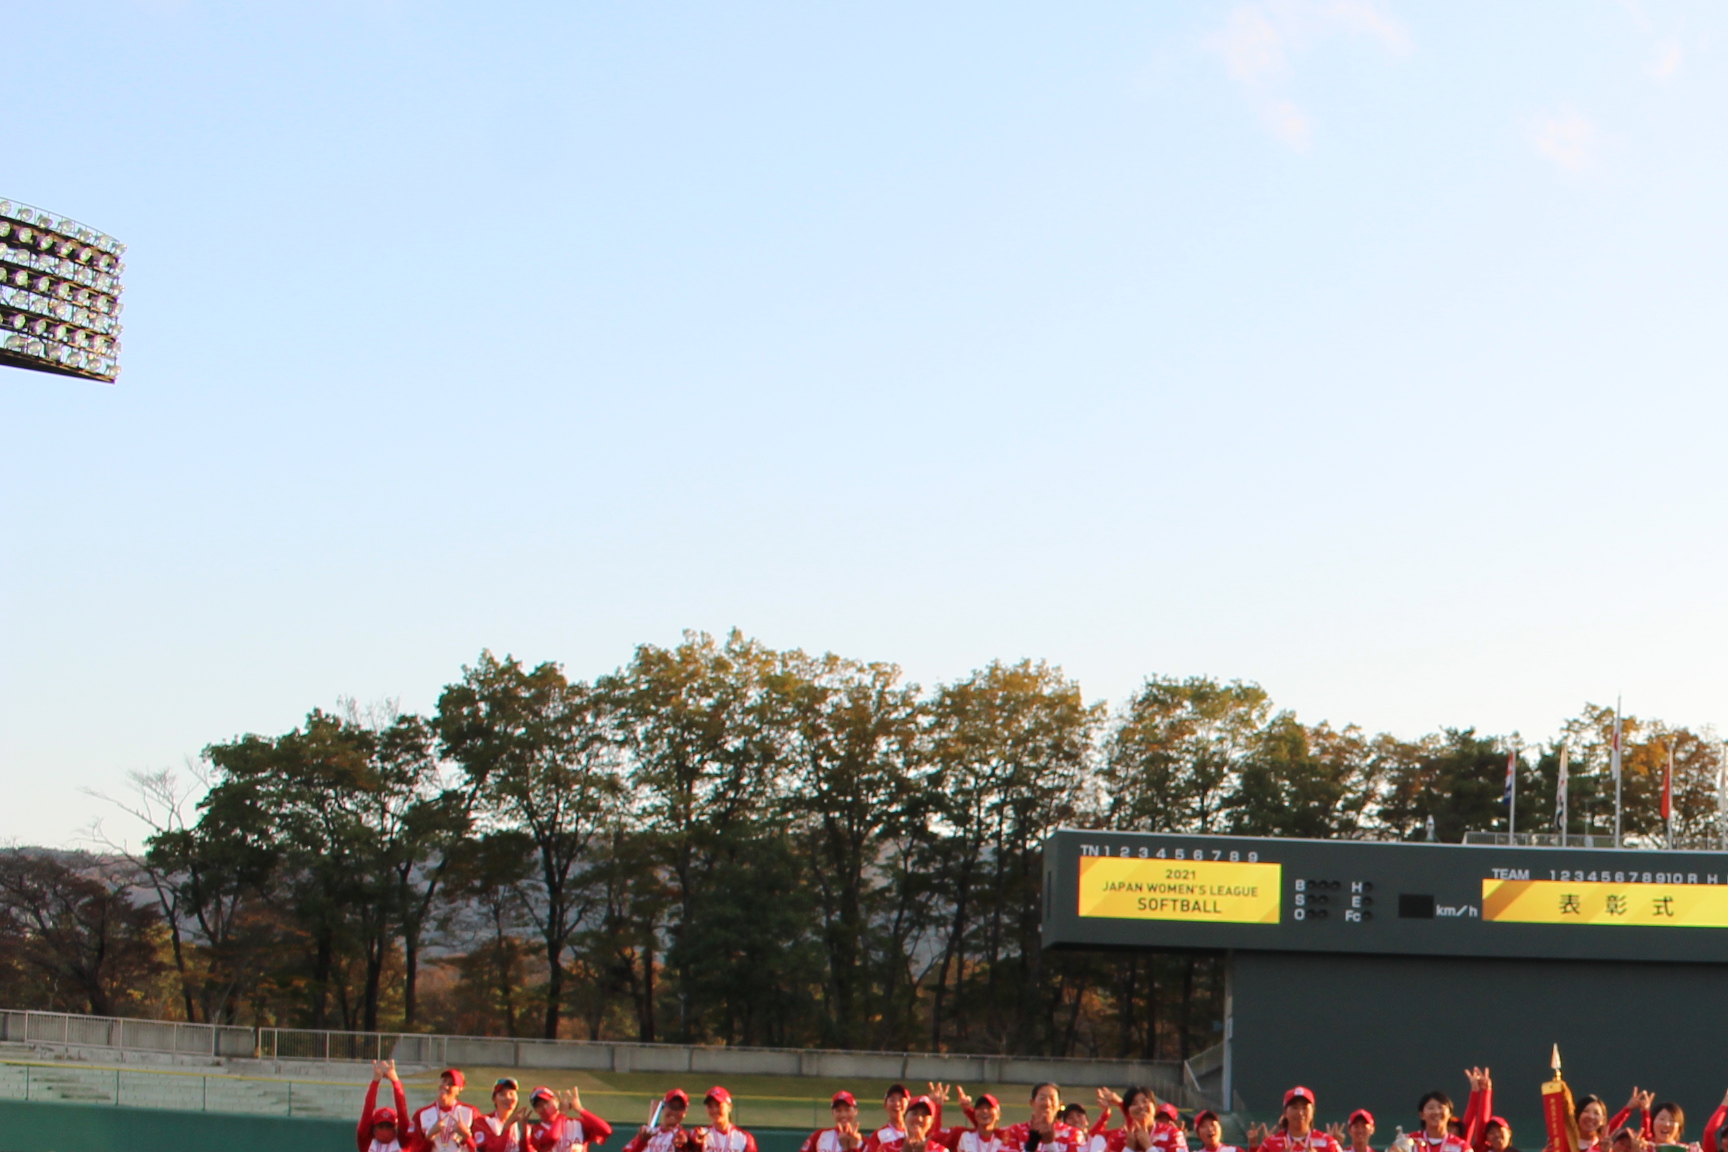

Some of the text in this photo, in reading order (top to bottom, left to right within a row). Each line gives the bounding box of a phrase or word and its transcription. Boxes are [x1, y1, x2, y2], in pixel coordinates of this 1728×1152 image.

[1080, 844, 1258, 863] TN 1 2 3 4 5 6 7 8 9
[1165, 869, 1197, 880] 2021
[1491, 868, 1530, 880] TEAM
[1549, 870, 1556, 880] 1
[1560, 870, 1570, 881] 2
[1574, 870, 1584, 881] 3
[1587, 871, 1598, 881] 4
[1601, 871, 1611, 882] 5
[1615, 871, 1625, 882] 6
[1628, 872, 1639, 883] 7
[1642, 872, 1651, 883] 8
[1687, 873, 1698, 884] R
[1707, 873, 1718, 884] H
[1102, 881, 1258, 897] JAPAN WOMEN'S LEAGUE
[1295, 879, 1306, 892] B
[1351, 881, 1362, 893] H
[1137, 897, 1222, 914] SOFTBALL
[1295, 893, 1305, 907] S
[1351, 895, 1361, 908] E
[1294, 908, 1306, 920] O
[1345, 909, 1361, 922] Fc
[1436, 904, 1478, 917] km/h
